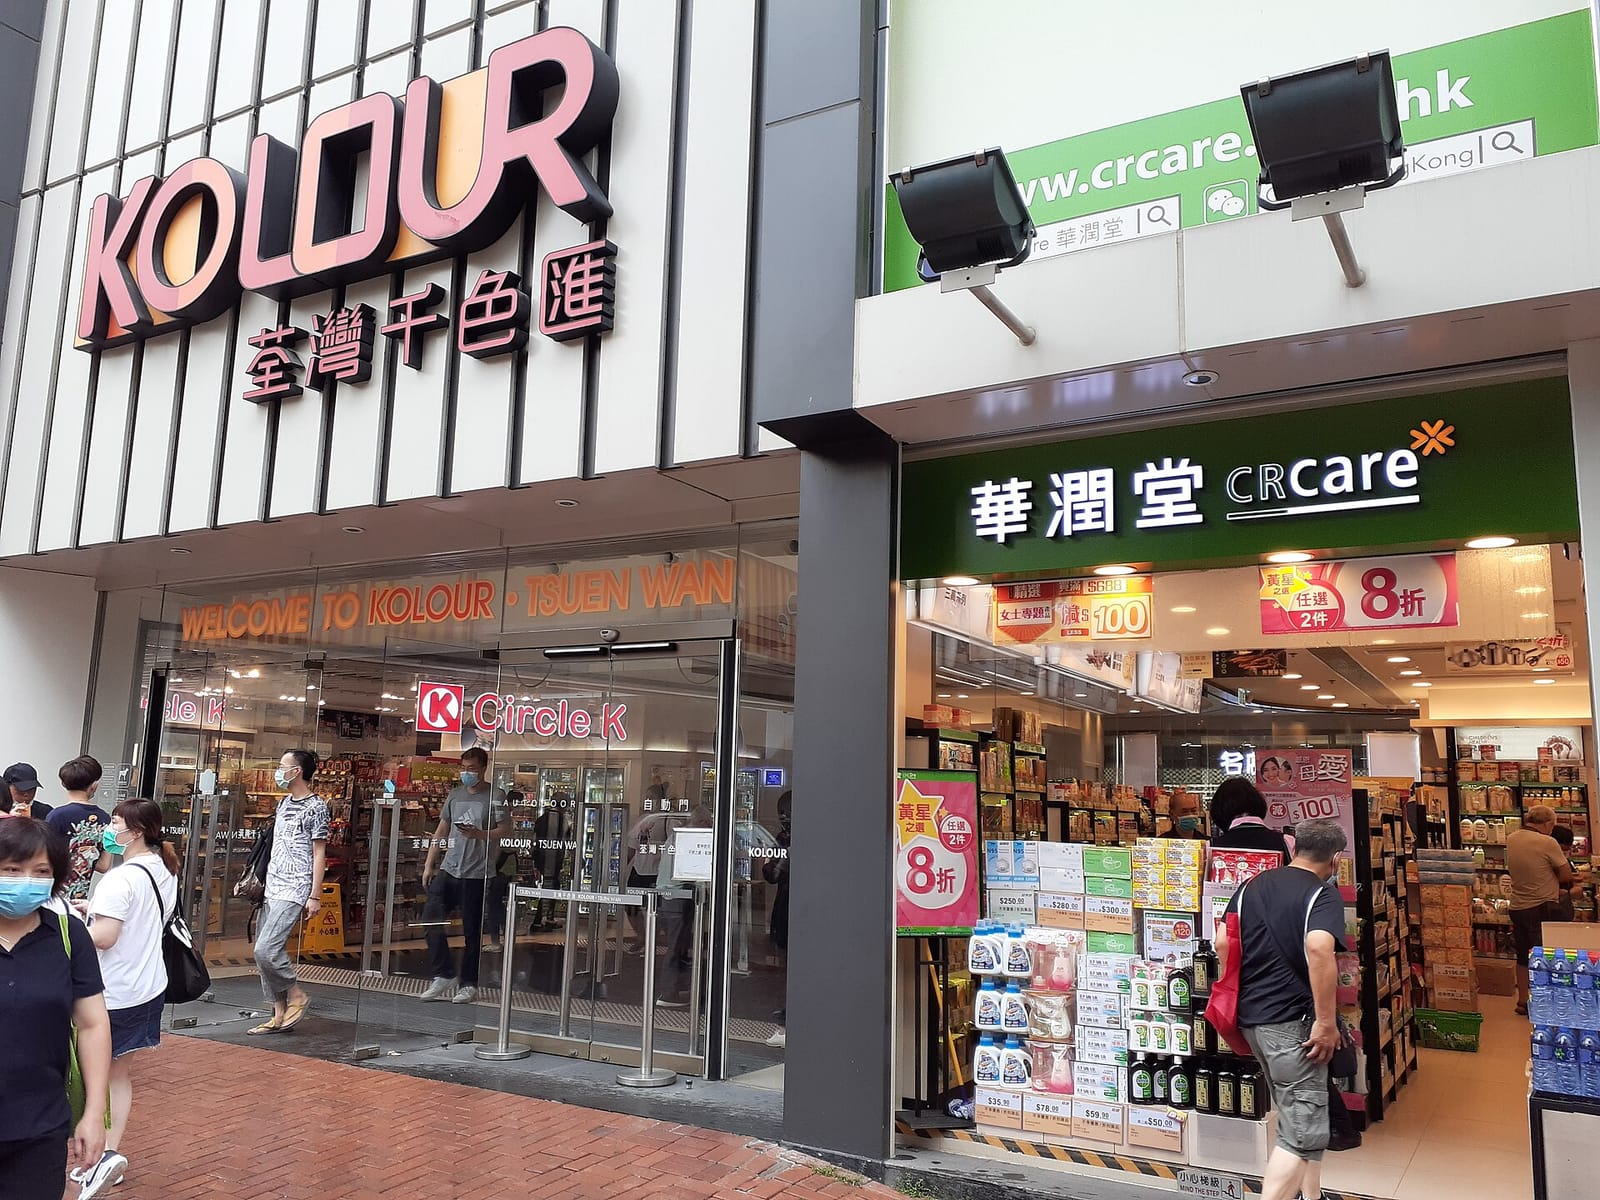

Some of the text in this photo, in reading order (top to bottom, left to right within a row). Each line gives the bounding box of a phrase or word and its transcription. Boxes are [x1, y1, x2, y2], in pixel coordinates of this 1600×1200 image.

[78, 26, 615, 346] KOLOUR
[1056, 217, 1124, 250] 華潤堂
[243, 240, 617, 403] 荃灣千色匯
[970, 448, 1420, 544] 華潤堂 CRcare
[1266, 573, 1295, 588] 黃星
[181, 558, 735, 642] WELCOME TO KOLOUR TSUEN WAN
[1296, 591, 1329, 608] 任選
[1360, 566, 1426, 620] 8折
[999, 607, 1045, 621] 女士專題
[1300, 611, 1329, 628] 2件
[473, 692, 592, 740] Circle
[601, 702, 628, 742] K
[1298, 753, 1349, 784] 母愛
[643, 799, 689, 812] 自動門
[898, 803, 931, 821] 黃星
[1292, 797, 1334, 820] $100
[905, 822, 926, 833] 之選
[947, 821, 966, 832] 任選
[500, 838, 578, 850] KOLOUR TSUEN WA
[949, 833, 967, 846] 2件
[748, 847, 788, 859] KOLOUR
[905, 845, 957, 895] 8折
[1179, 1171, 1220, 1189] 小心梯級
[1179, 1184, 1194, 1193] MIND
[1206, 1188, 1220, 1196] STEP
